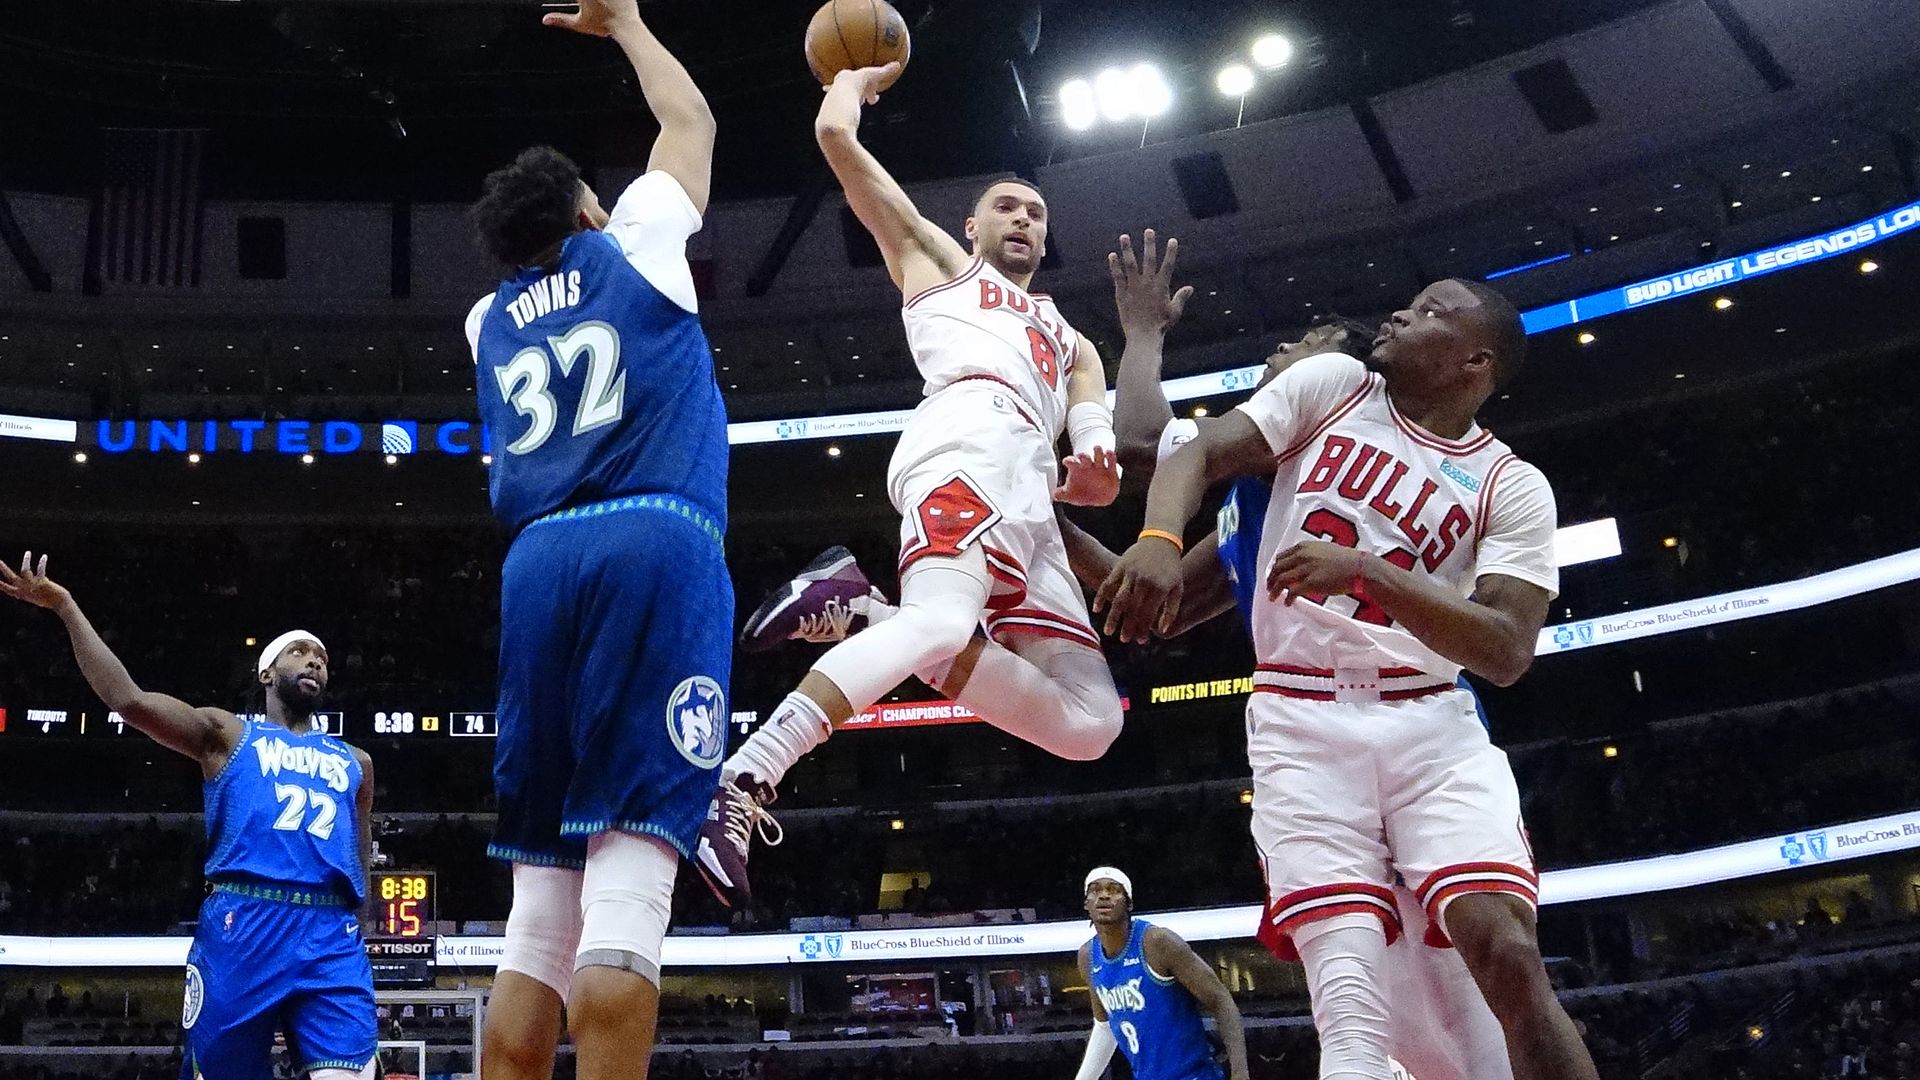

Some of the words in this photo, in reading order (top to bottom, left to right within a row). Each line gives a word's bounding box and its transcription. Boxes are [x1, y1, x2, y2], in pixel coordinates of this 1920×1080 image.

[1627, 281, 1672, 305] BUD
[1673, 263, 1736, 293] LIGHT
[1741, 224, 1877, 274] LEGENDS
[506, 270, 581, 330] TOWNS
[979, 278, 1070, 360] BULL
[1025, 326, 1058, 392] 8
[494, 320, 627, 456] 32
[99, 419, 362, 454] UNITED
[1296, 434, 1473, 575] BULLS
[1602, 618, 1655, 634] BlueCross
[1657, 605, 1717, 624] BlueShield
[1719, 602, 1729, 611] of
[1732, 597, 1770, 609] Illinois
[1151, 683, 1195, 703] POINTS
[1195, 682, 1208, 698] IN
[1210, 679, 1232, 696] THE
[1233, 677, 1254, 693] PAI
[27, 709, 67, 723] TIMEOUTS
[374, 711, 414, 734] 8:38
[465, 715, 484, 733] 74
[731, 711, 758, 723] FOULS
[883, 706, 952, 721] CHAMPIONS
[251, 736, 352, 793] WOLVES
[272, 781, 338, 841] 22
[1836, 830, 1901, 848] BlueCross
[381, 877, 427, 900] 8:38
[389, 901, 421, 937] 15
[382, 943, 432, 954] TISSOT
[456, 945, 468, 955] of
[851, 938, 908, 950] BlueCross
[910, 936, 971, 948] BlueShield
[973, 935, 984, 945] of
[987, 934, 1025, 945] Illinois
[1096, 976, 1146, 1014] WOLVES
[1120, 1020, 1139, 1054] 8
